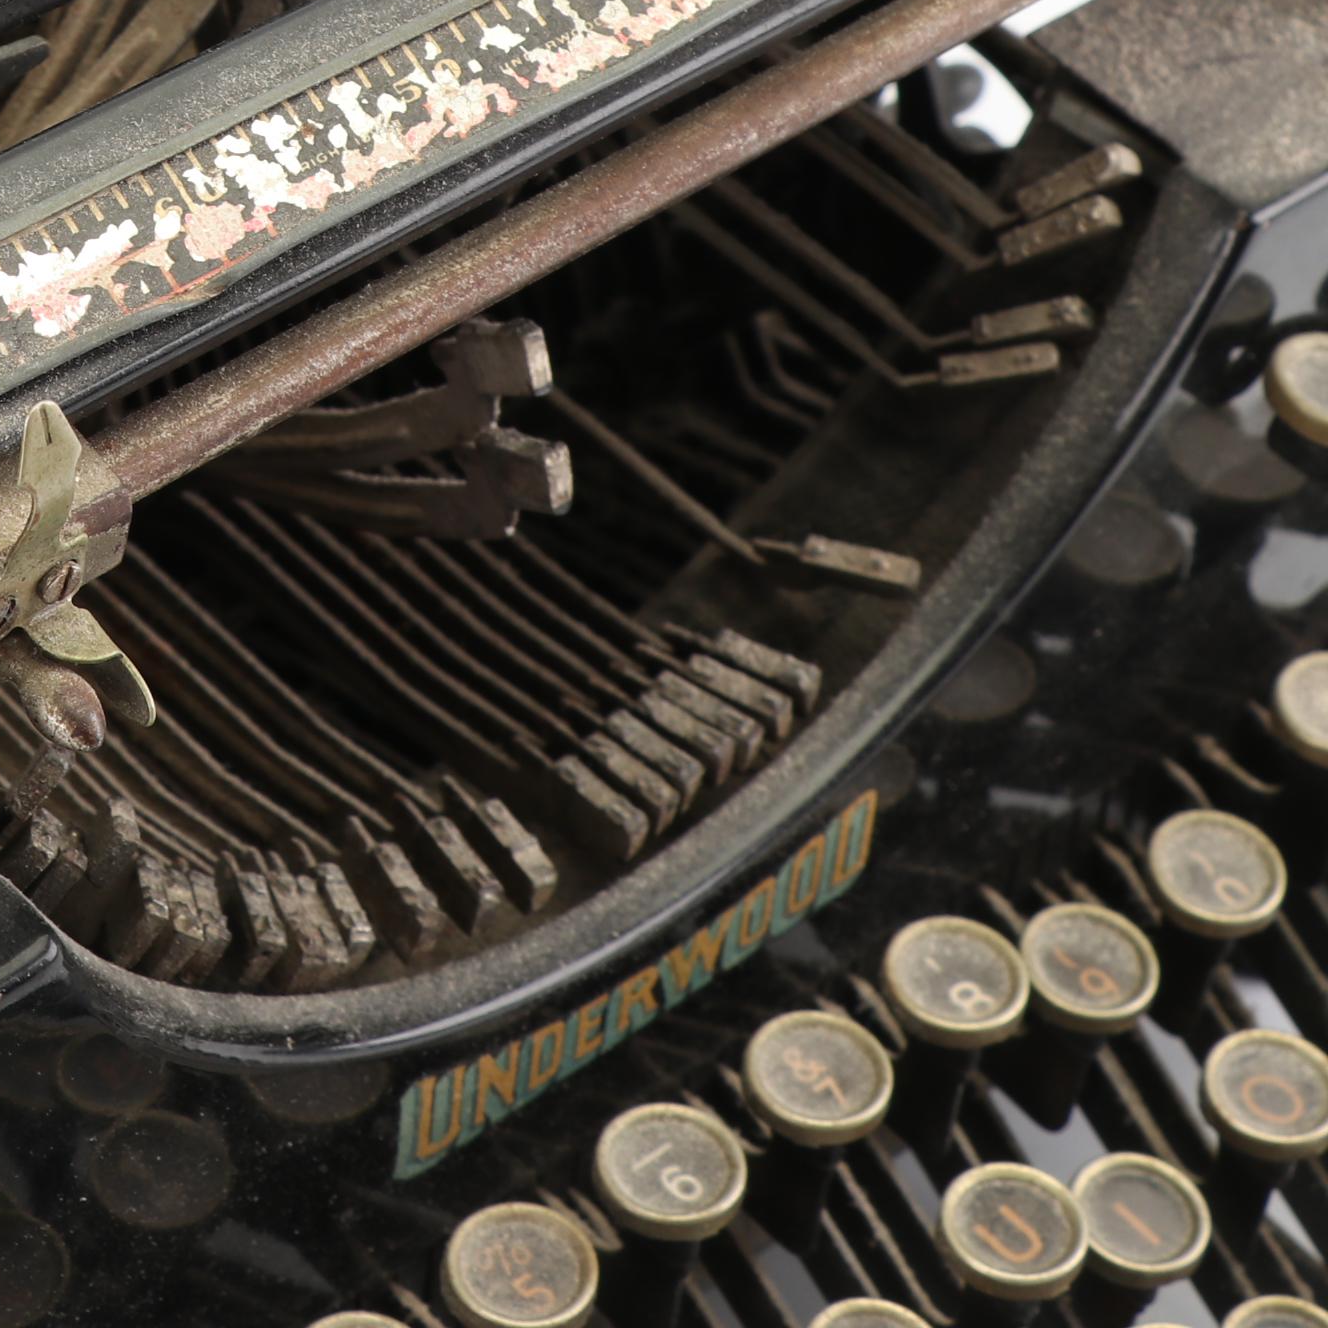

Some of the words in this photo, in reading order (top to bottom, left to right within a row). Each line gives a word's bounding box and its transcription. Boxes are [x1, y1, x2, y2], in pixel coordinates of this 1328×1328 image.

[394, 789, 878, 1180] UNDERWOOD
[949, 981, 996, 1019] 8
[1080, 966, 1119, 997] 9
[813, 1075, 852, 1115] 7
[661, 1165, 704, 1202] 6
[973, 1203, 1043, 1264] U
[512, 1273, 557, 1312] 5
